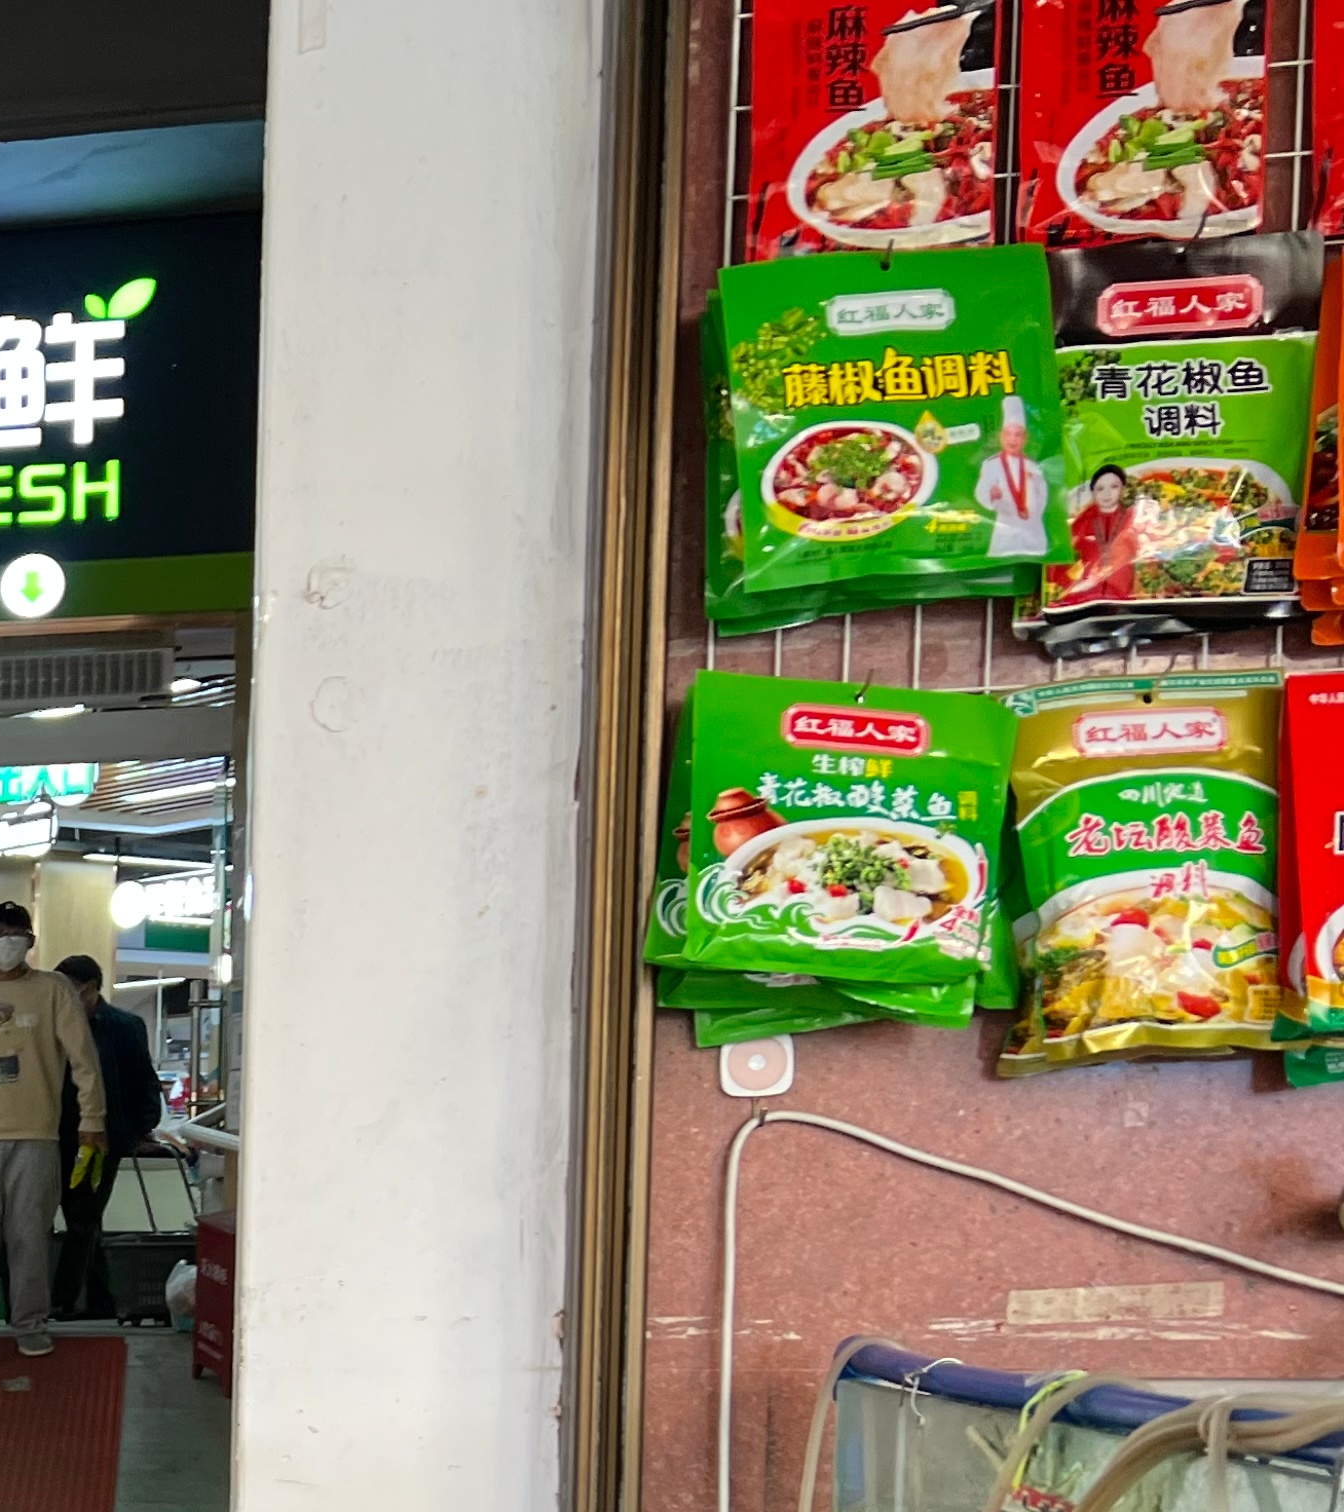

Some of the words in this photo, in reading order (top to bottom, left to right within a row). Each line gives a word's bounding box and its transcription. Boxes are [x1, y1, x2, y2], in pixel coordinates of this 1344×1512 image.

[825, 5, 868, 112] 麻辣鱼
[836, 302, 945, 325] 红福人家
[1110, 291, 1249, 319] 红福人家
[782, 347, 1016, 408] 藤椒鱼调料
[1093, 361, 1271, 400] 青花椒鱼
[1144, 404, 1221, 437] 调料
[793, 714, 918, 743] 红福人家
[1085, 721, 1219, 745] 红福人家
[757, 771, 958, 821] 青花椒酸菜鱼
[1065, 810, 1267, 857] 老坛酸菜鱼
